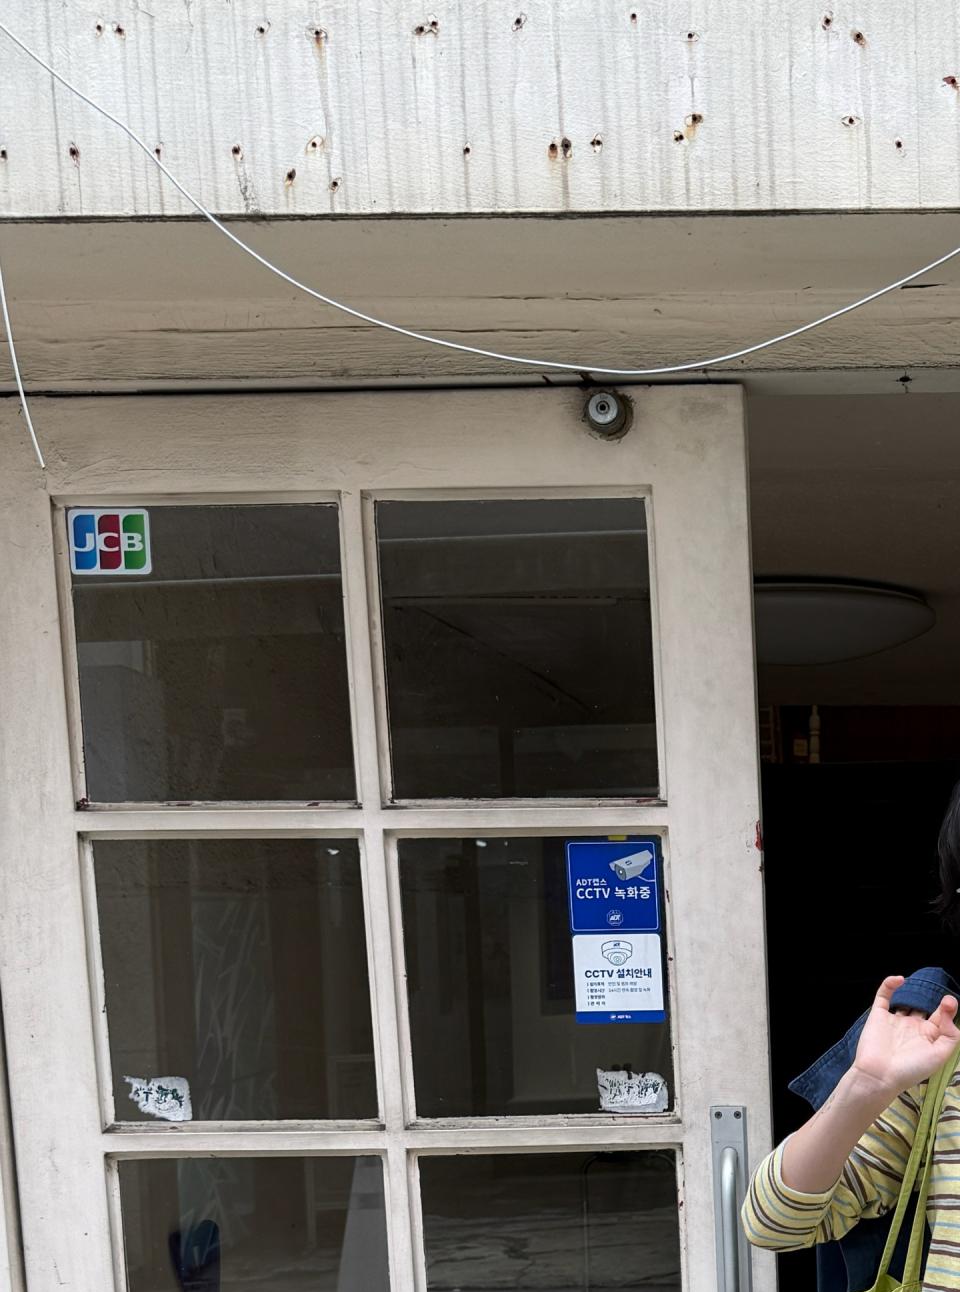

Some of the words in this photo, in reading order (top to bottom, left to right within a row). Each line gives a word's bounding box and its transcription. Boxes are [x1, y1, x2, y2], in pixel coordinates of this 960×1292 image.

[73, 532, 144, 552] JCB
[576, 878, 607, 887] ADT캡스
[576, 887, 611, 900] CCTV
[614, 886, 651, 900] 녹화중
[585, 968, 614, 979] CCTV
[616, 967, 652, 979] 설치안내
